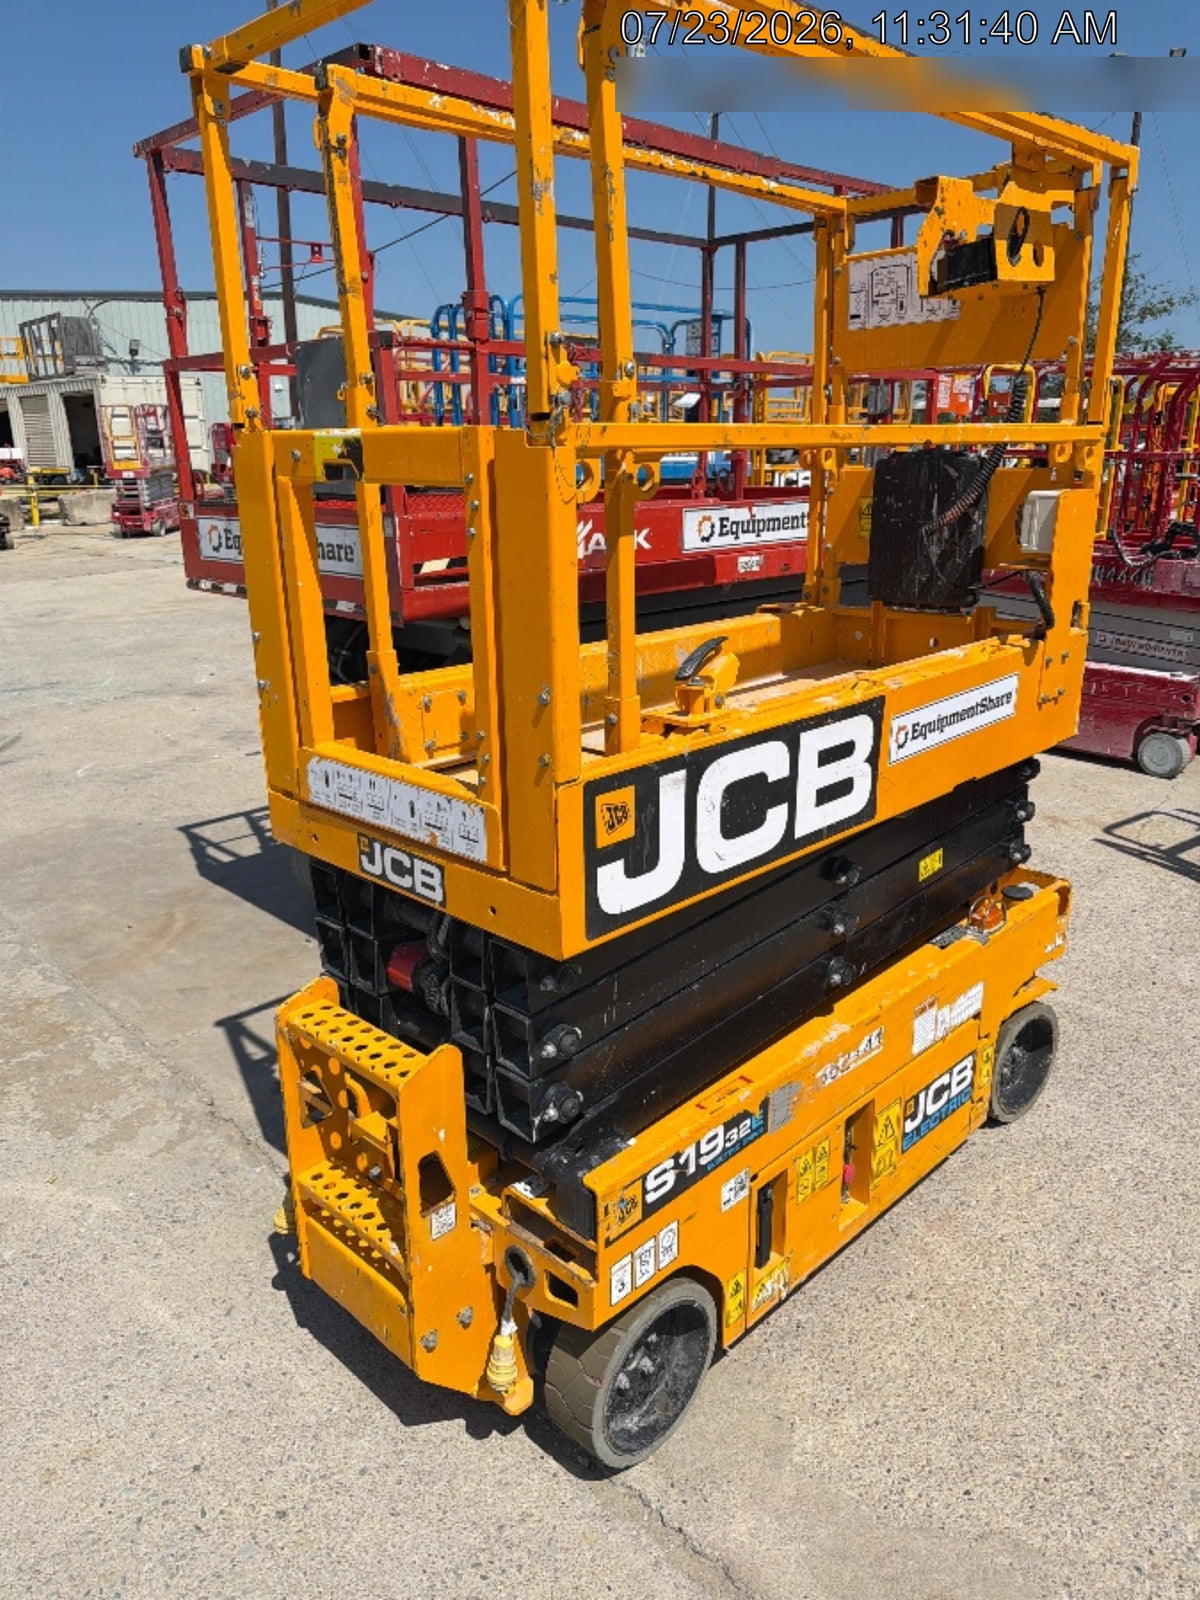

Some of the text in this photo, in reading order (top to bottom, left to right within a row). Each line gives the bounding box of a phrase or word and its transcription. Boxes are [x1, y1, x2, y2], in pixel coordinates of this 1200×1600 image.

[717, 511, 810, 540] Equipment
[910, 690, 1012, 740] EquipmentShare
[597, 714, 874, 915] JCB
[360, 842, 443, 902] JCB
[903, 1085, 972, 1151] ELECTRIC
[904, 1055, 974, 1134] JCB
